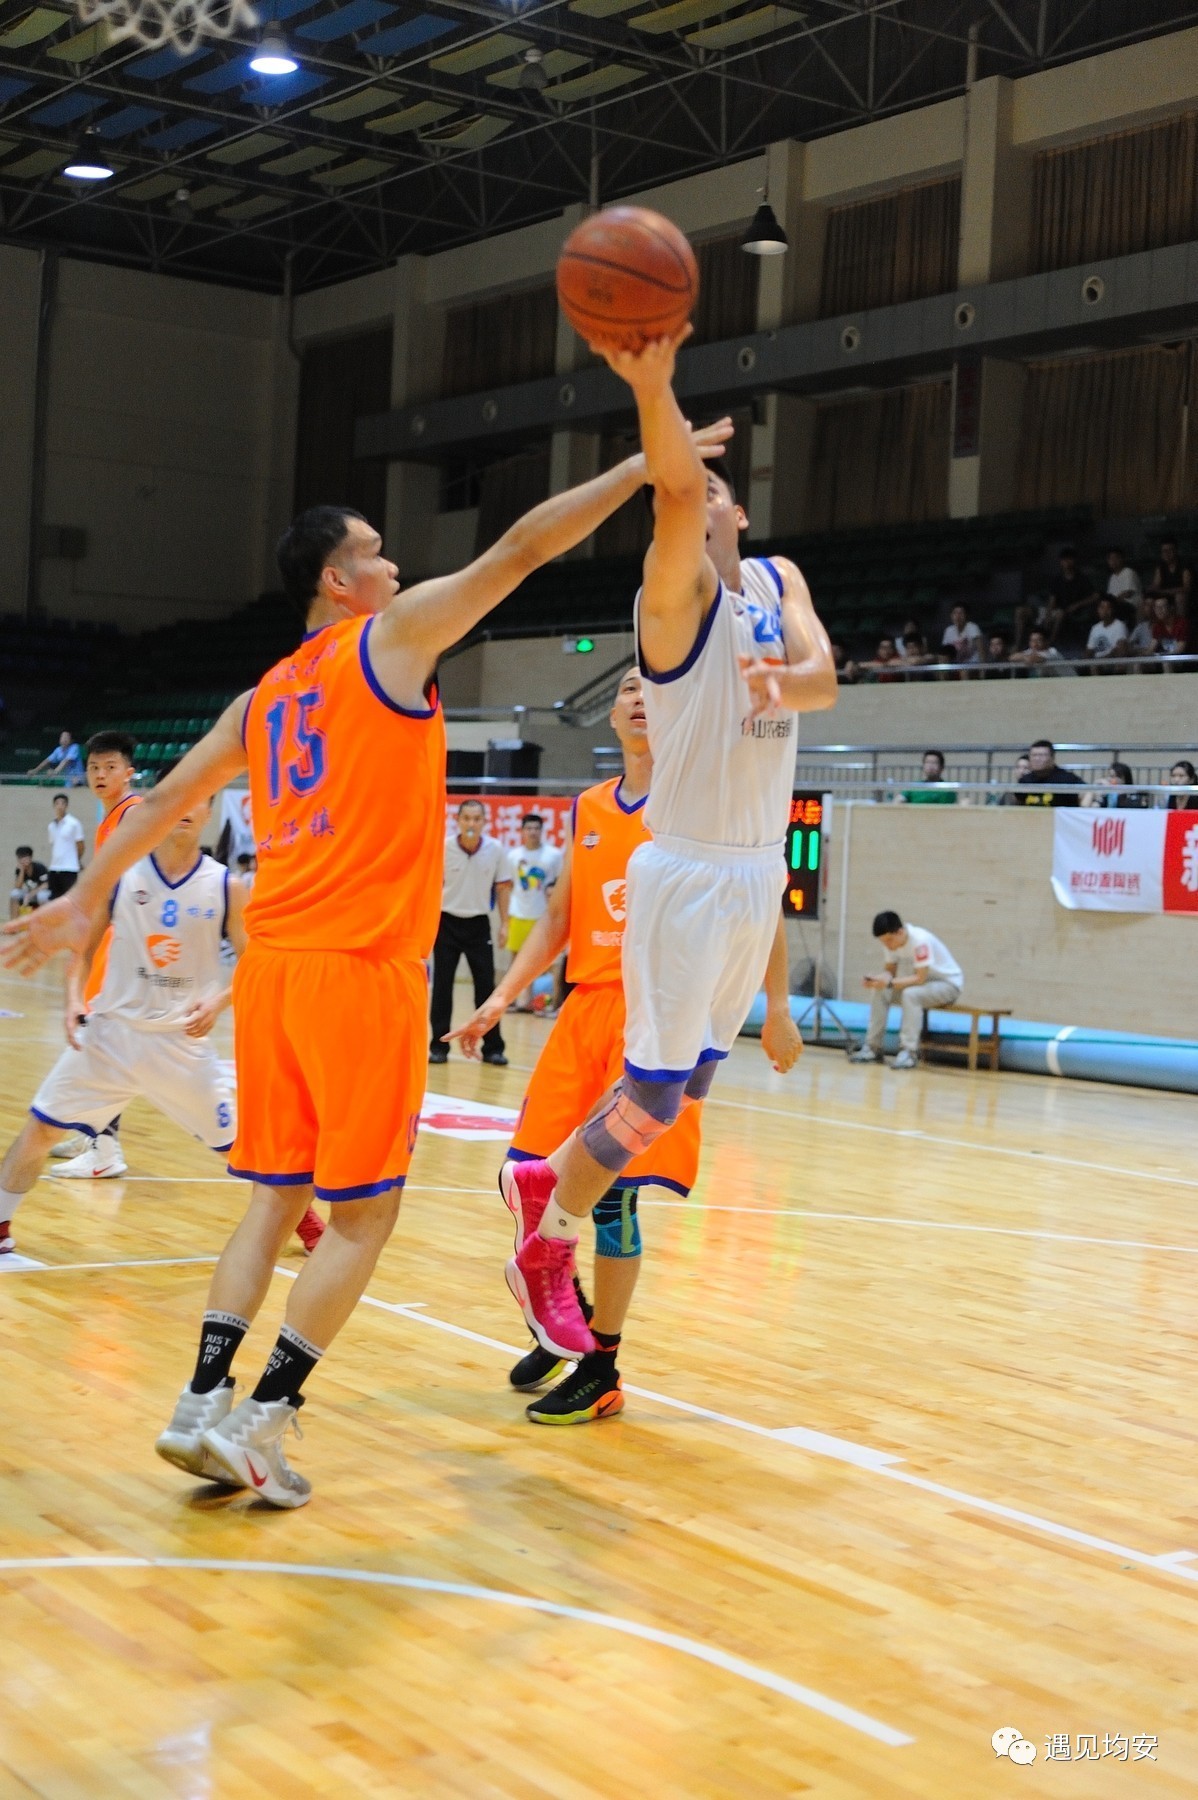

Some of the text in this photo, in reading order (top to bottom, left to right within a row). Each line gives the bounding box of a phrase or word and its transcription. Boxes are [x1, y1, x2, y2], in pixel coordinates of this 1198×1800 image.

[264, 683, 327, 808] 15
[791, 829, 819, 870] 11
[161, 899, 178, 928] 8
[221, 1314, 242, 1327] TEN
[204, 1333, 232, 1347] JUST
[204, 1343, 222, 1356] DO
[202, 1354, 216, 1365] IT
